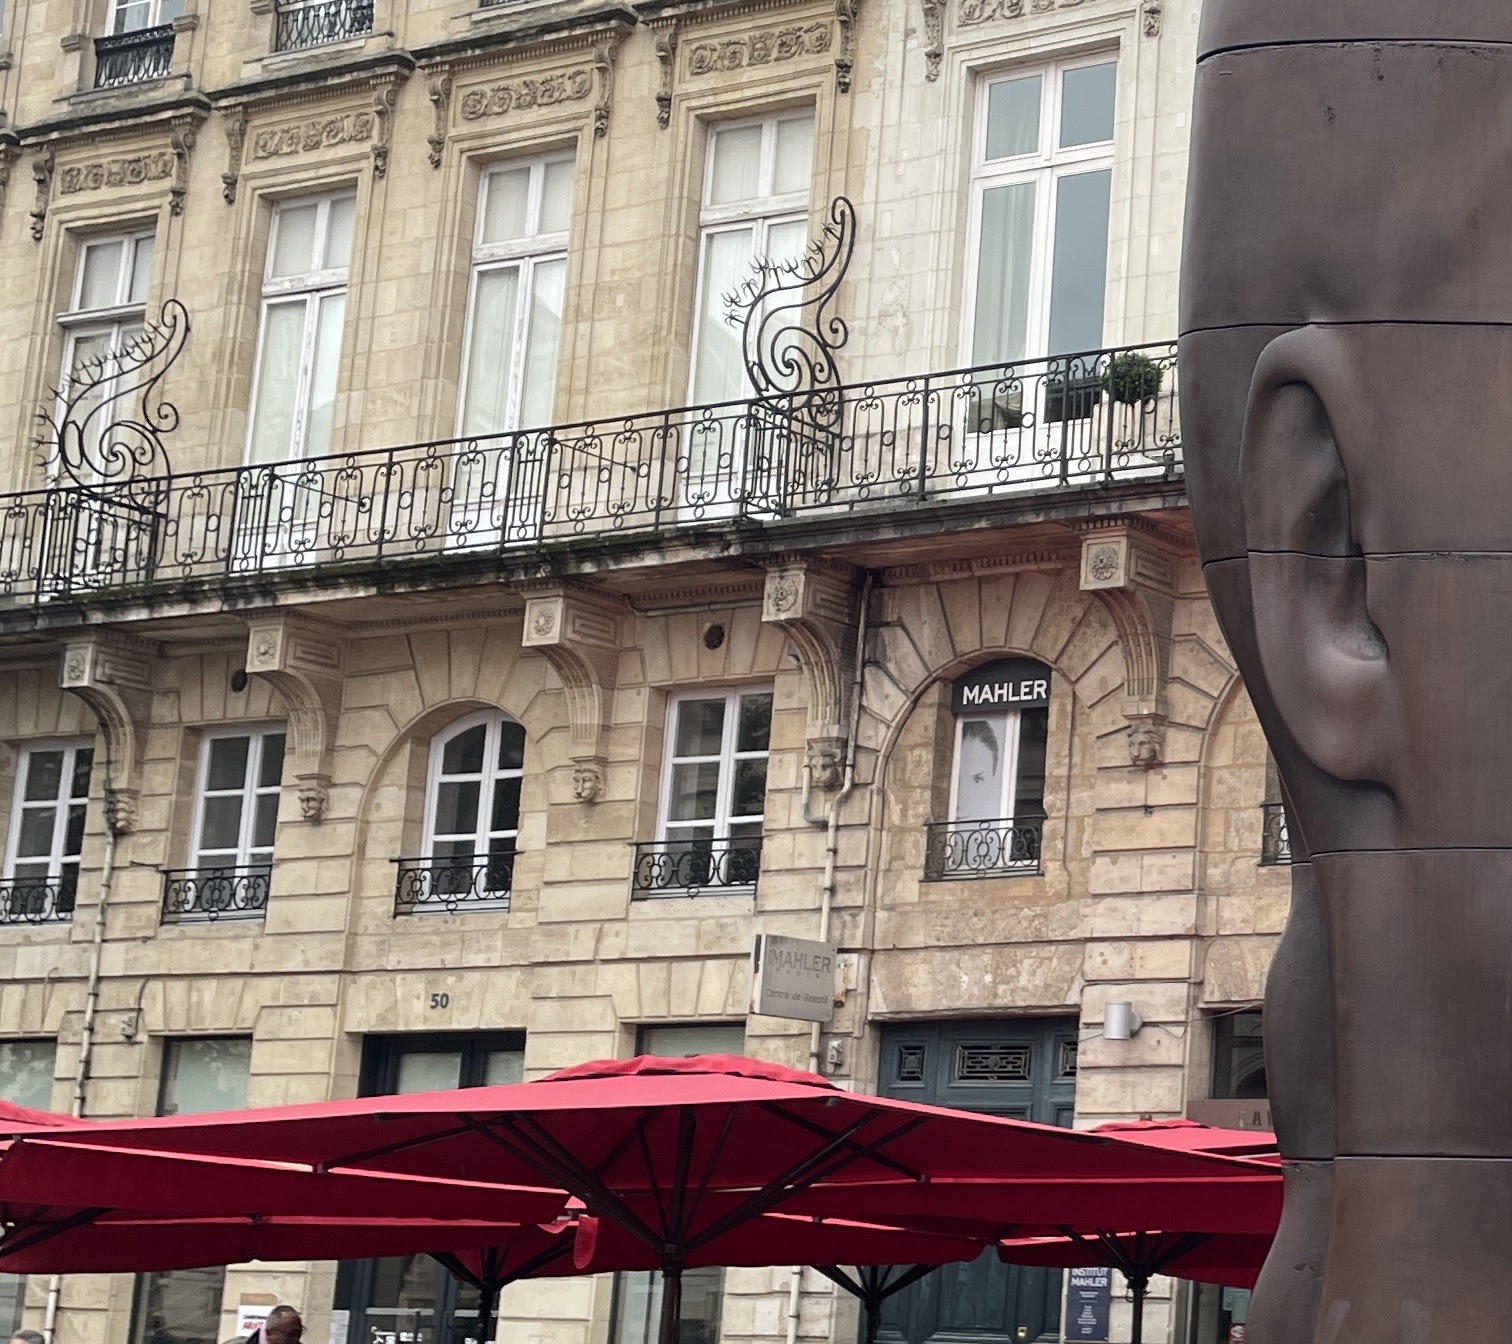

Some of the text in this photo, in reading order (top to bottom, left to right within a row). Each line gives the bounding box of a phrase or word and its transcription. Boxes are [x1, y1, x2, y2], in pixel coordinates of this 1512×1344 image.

[962, 679, 1048, 705] MAHLER
[767, 948, 832, 974] MAHLER
[430, 993, 450, 1010] 50
[1070, 1277, 1108, 1287] MAHLER
